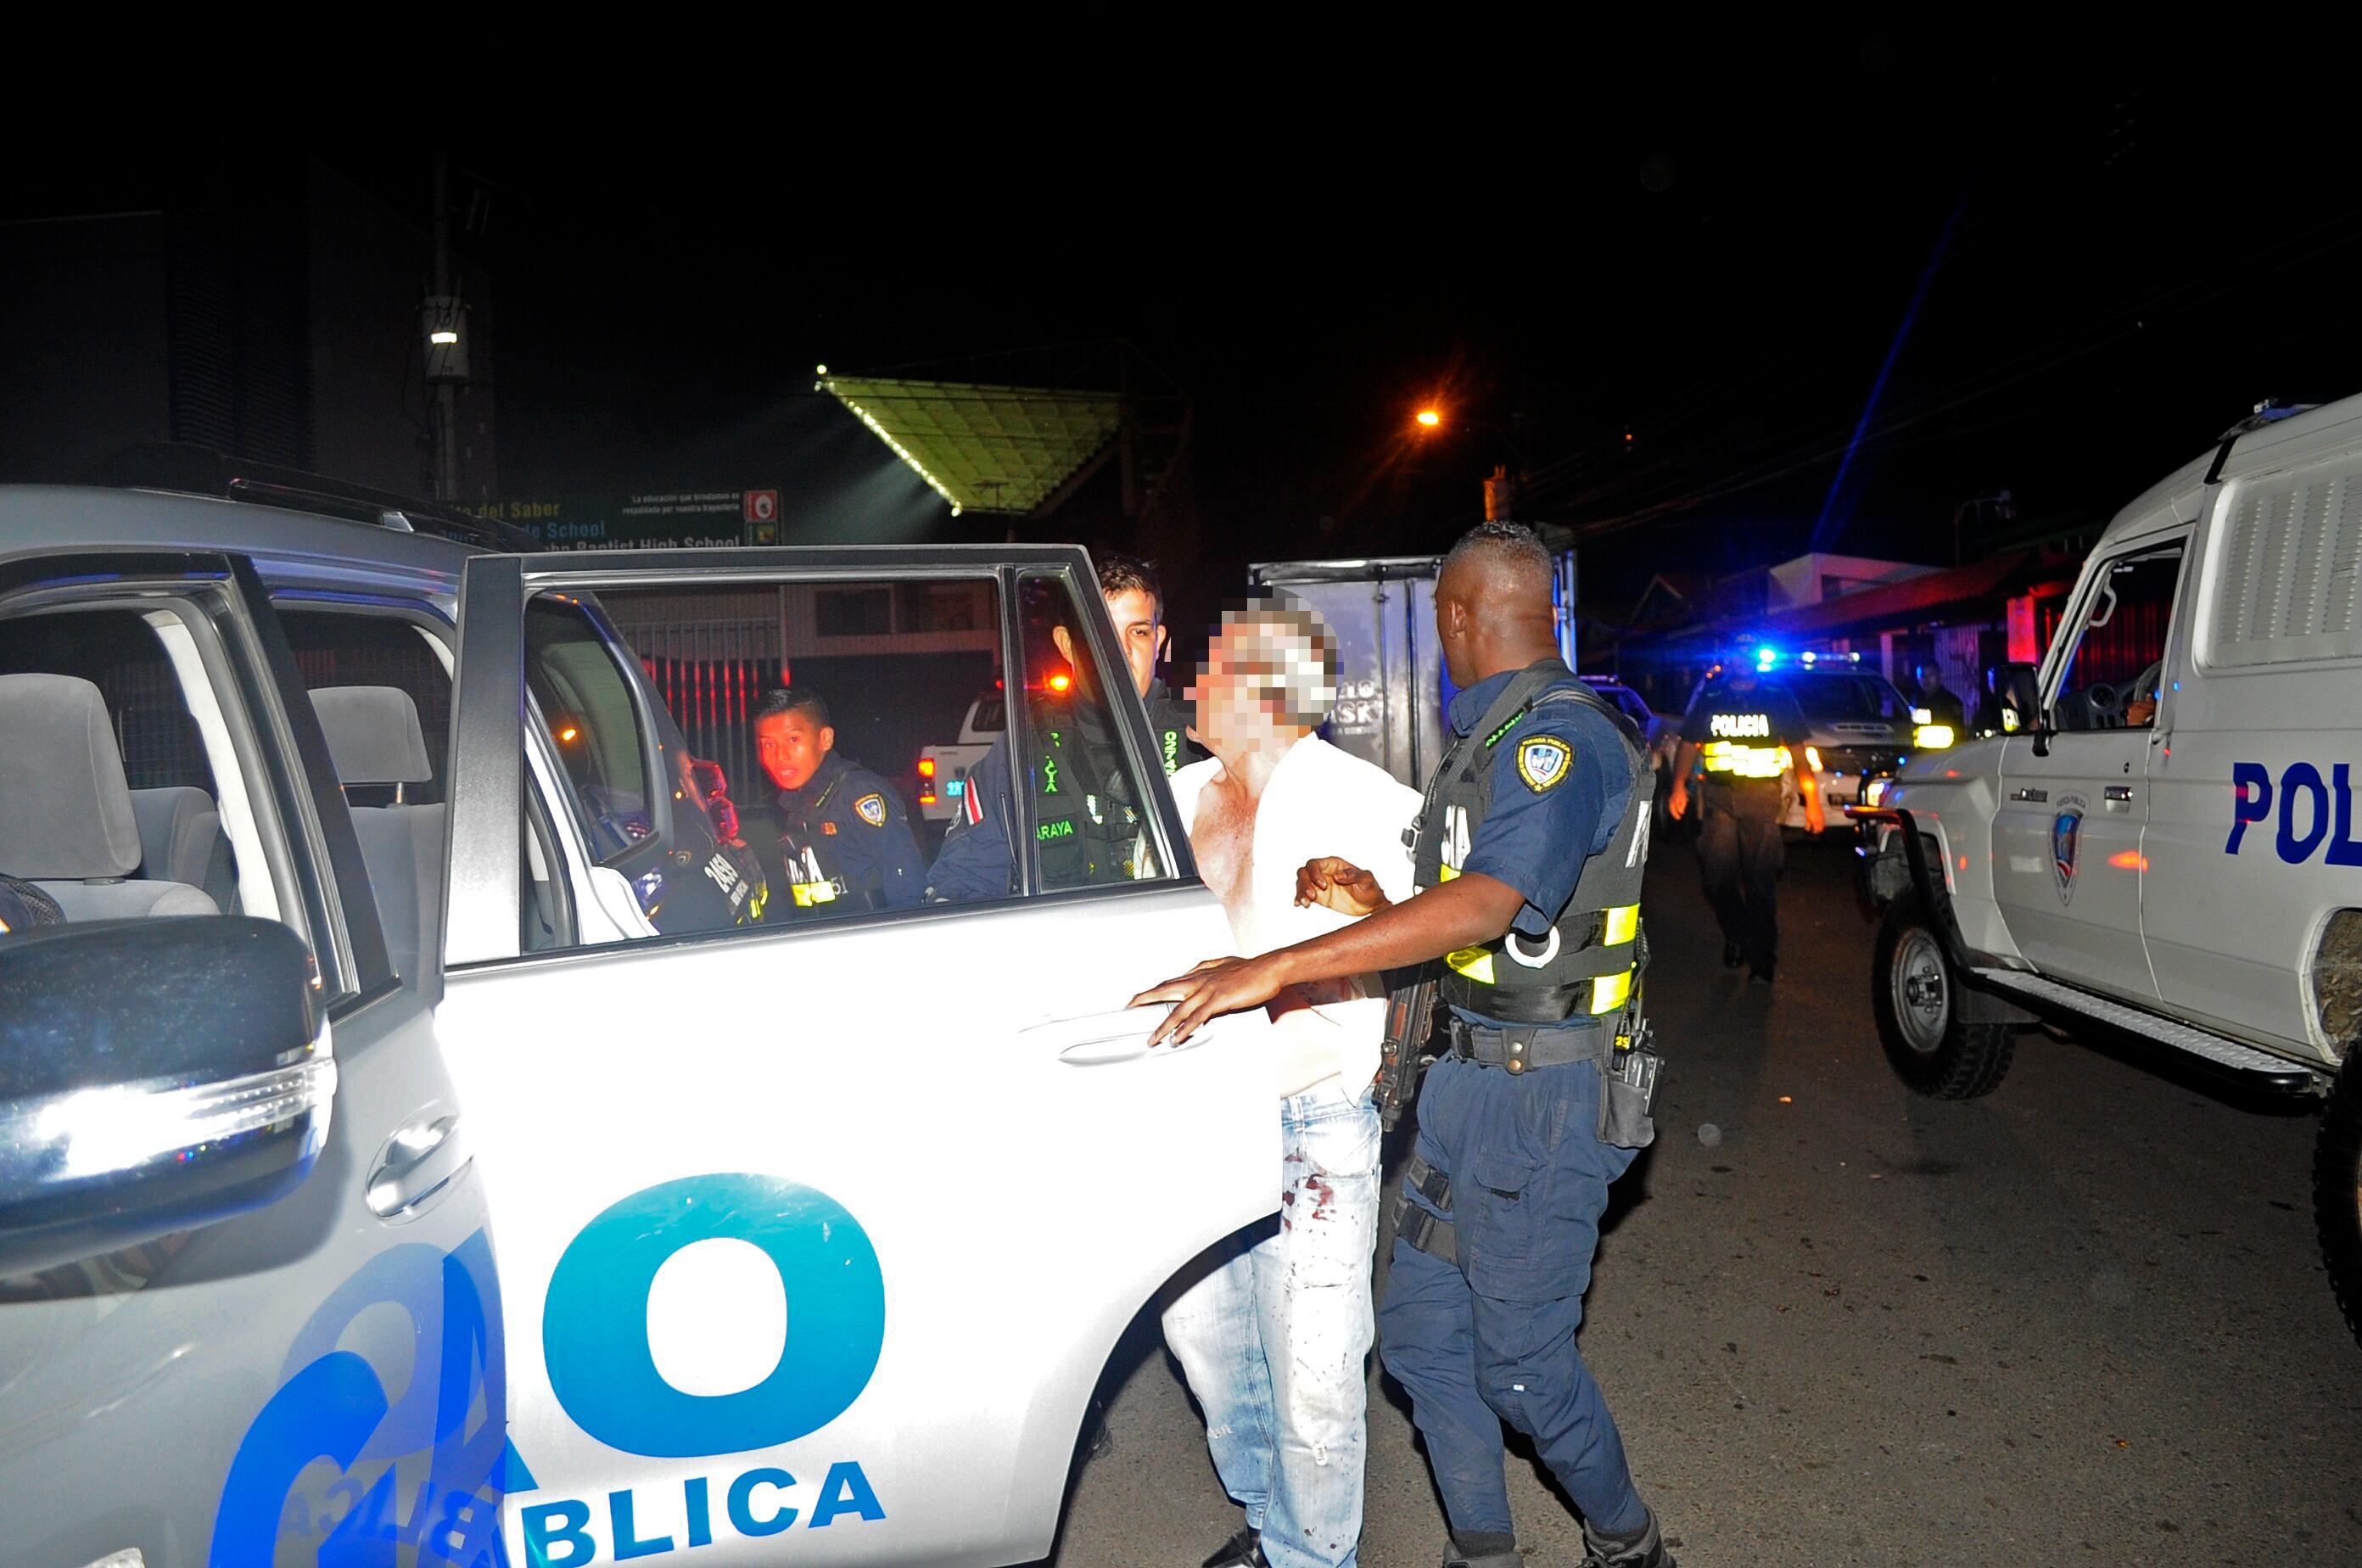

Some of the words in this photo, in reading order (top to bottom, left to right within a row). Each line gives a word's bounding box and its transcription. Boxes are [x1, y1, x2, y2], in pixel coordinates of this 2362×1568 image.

[511, 501, 562, 518] Saber
[547, 520, 605, 539] School
[641, 536, 677, 549] High
[685, 535, 741, 548] School
[1710, 714, 1770, 737] POLICIA
[2225, 761, 2362, 867] POL
